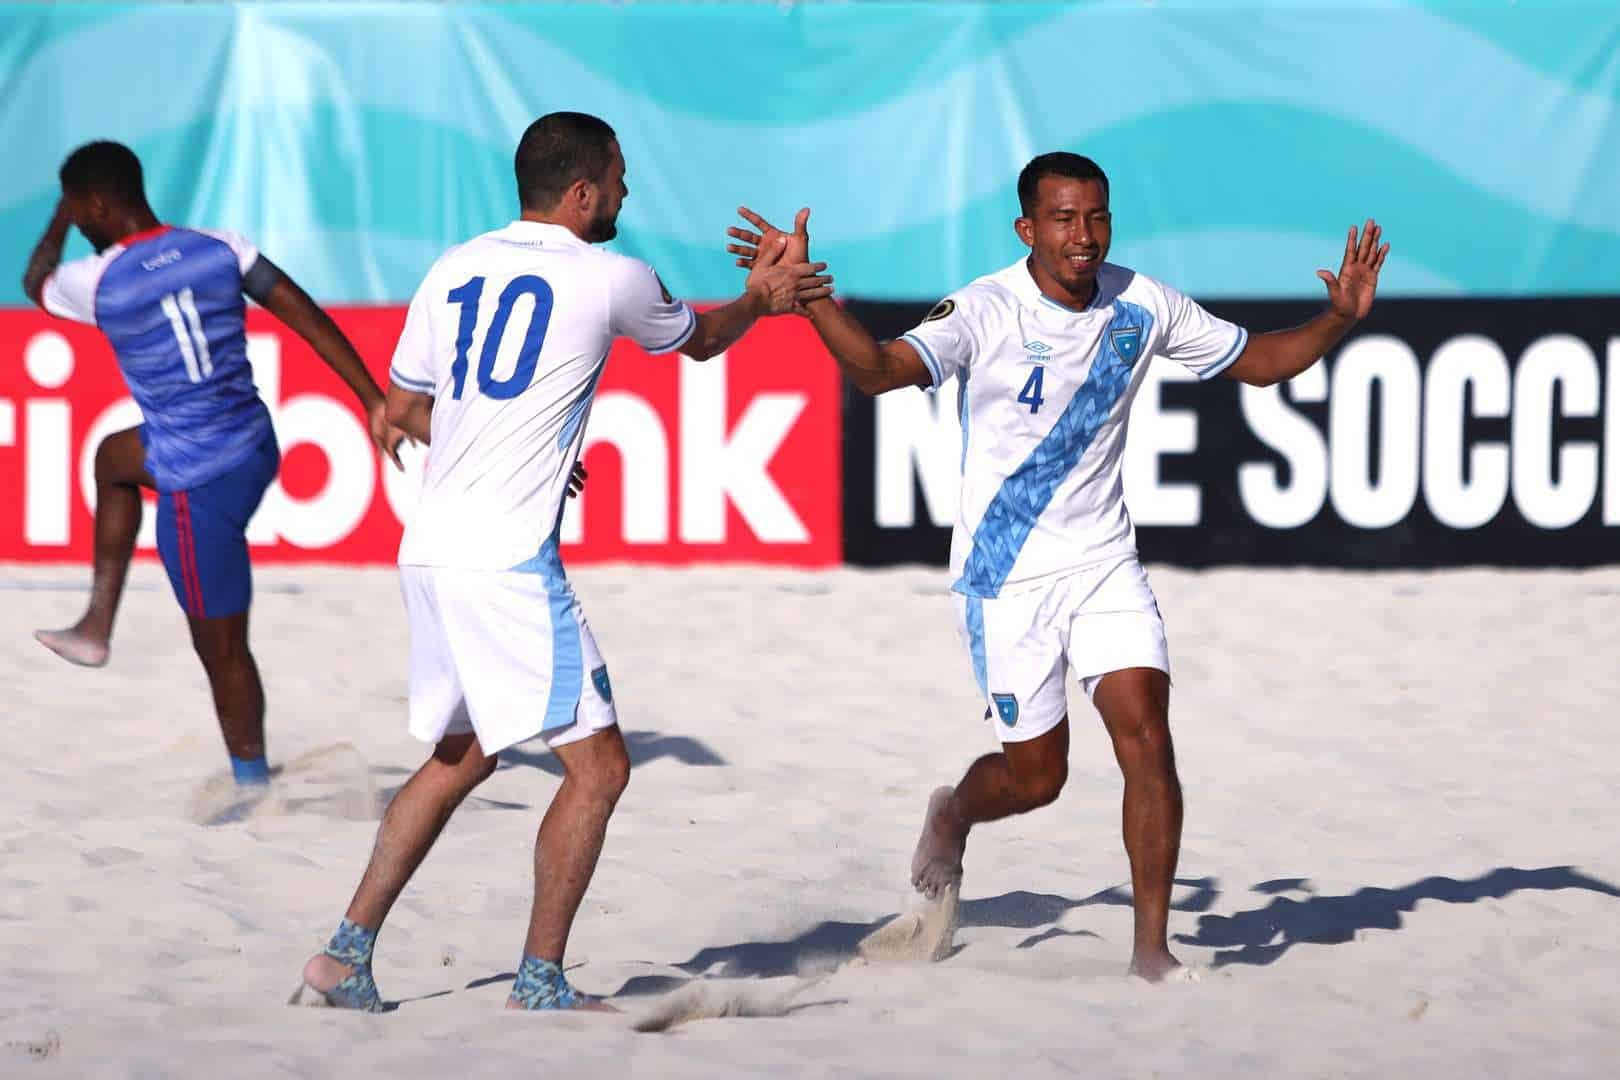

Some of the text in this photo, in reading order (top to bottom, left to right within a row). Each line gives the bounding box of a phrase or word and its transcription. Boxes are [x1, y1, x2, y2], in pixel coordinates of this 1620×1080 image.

[161, 288, 213, 384] 11
[446, 274, 554, 401] 10
[1017, 366, 1045, 414] 4
